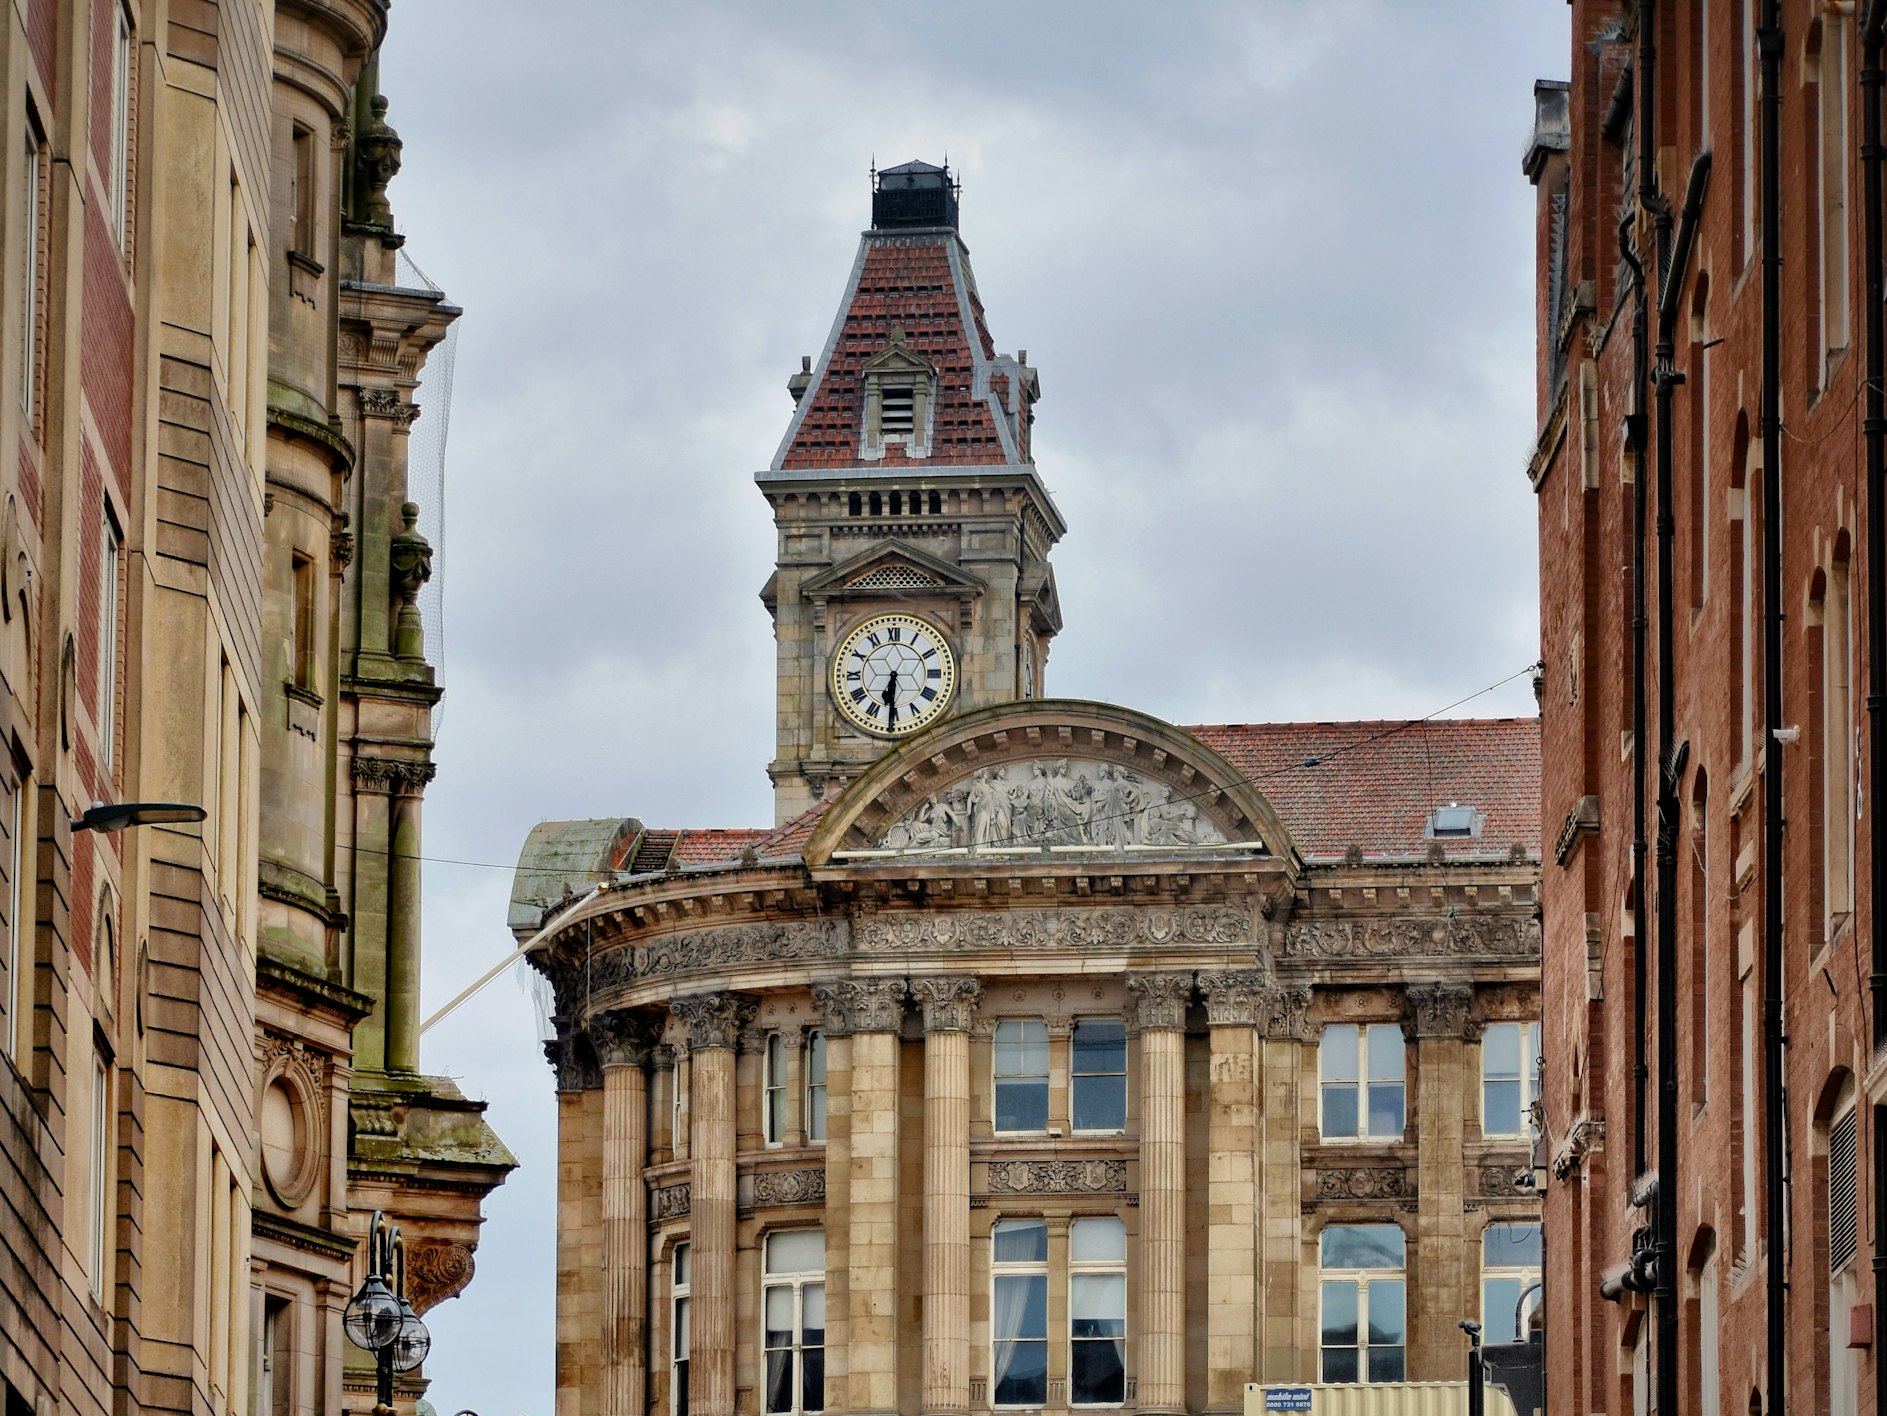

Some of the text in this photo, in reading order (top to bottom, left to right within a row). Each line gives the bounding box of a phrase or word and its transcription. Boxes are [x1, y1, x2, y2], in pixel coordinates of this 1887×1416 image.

[867, 632, 881, 649] XI
[887, 627, 901, 642] XII
[851, 649, 867, 662] X
[1266, 1392, 1310, 1401] mobile mini
